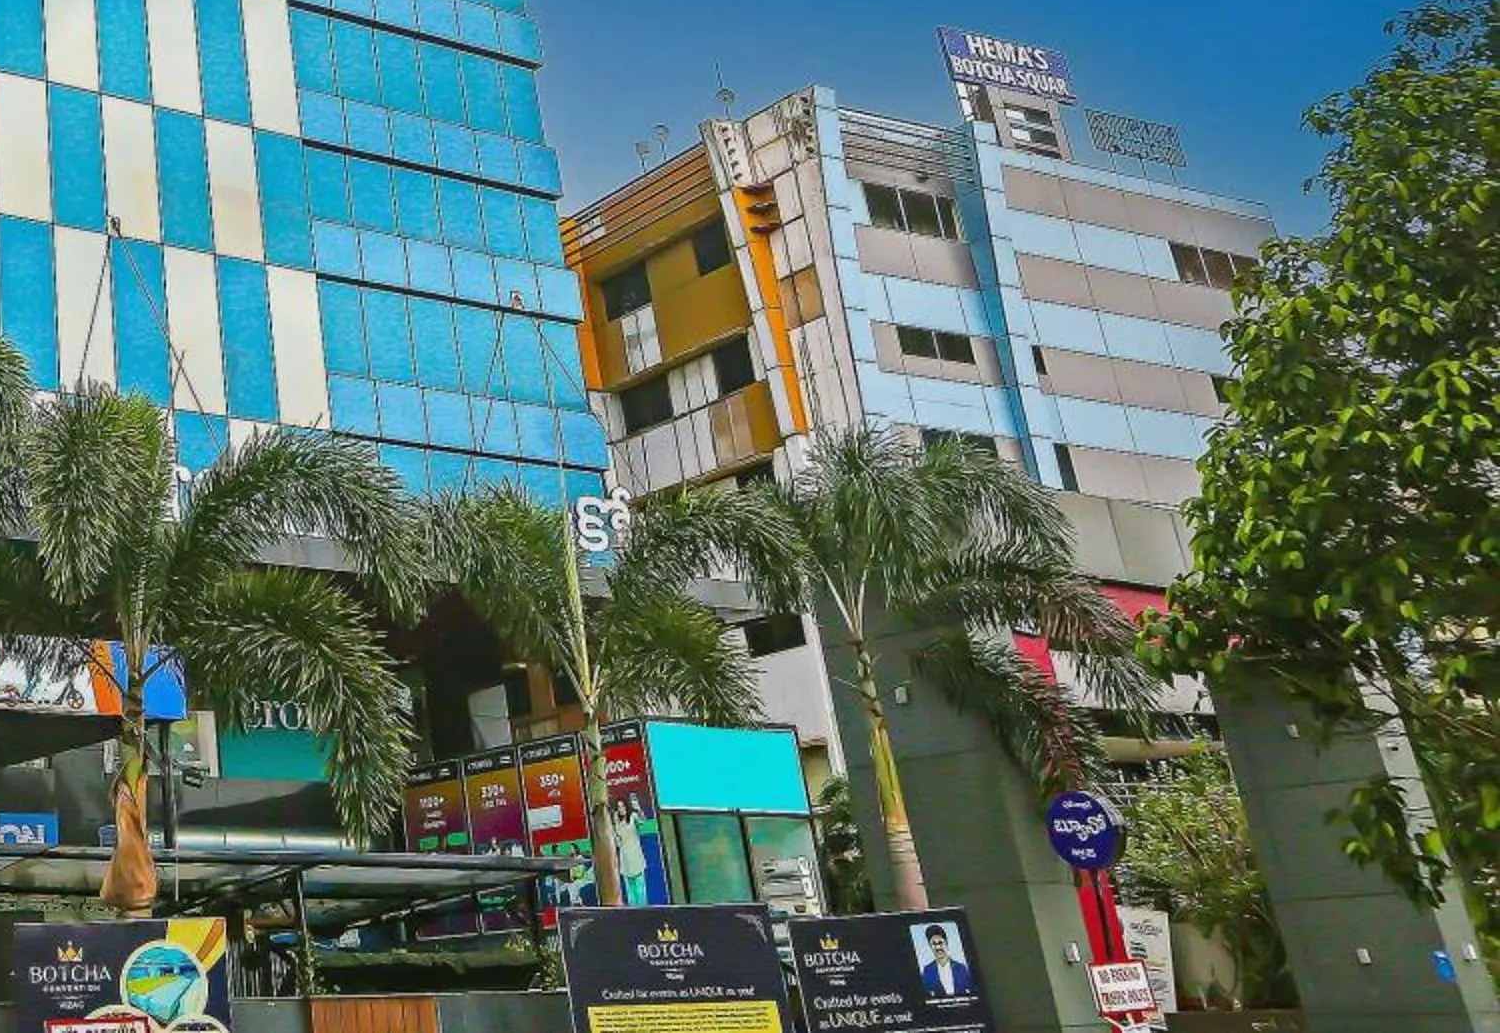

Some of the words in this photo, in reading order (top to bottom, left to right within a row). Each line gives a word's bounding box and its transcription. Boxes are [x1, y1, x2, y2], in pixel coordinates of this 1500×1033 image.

[966, 35, 1049, 70] HEMA'S
[950, 55, 1016, 85] BOTCHA
[637, 943, 705, 960] BOTCHA
[804, 951, 862, 967] BOTCHA
[29, 964, 112, 984] BOTCHA
